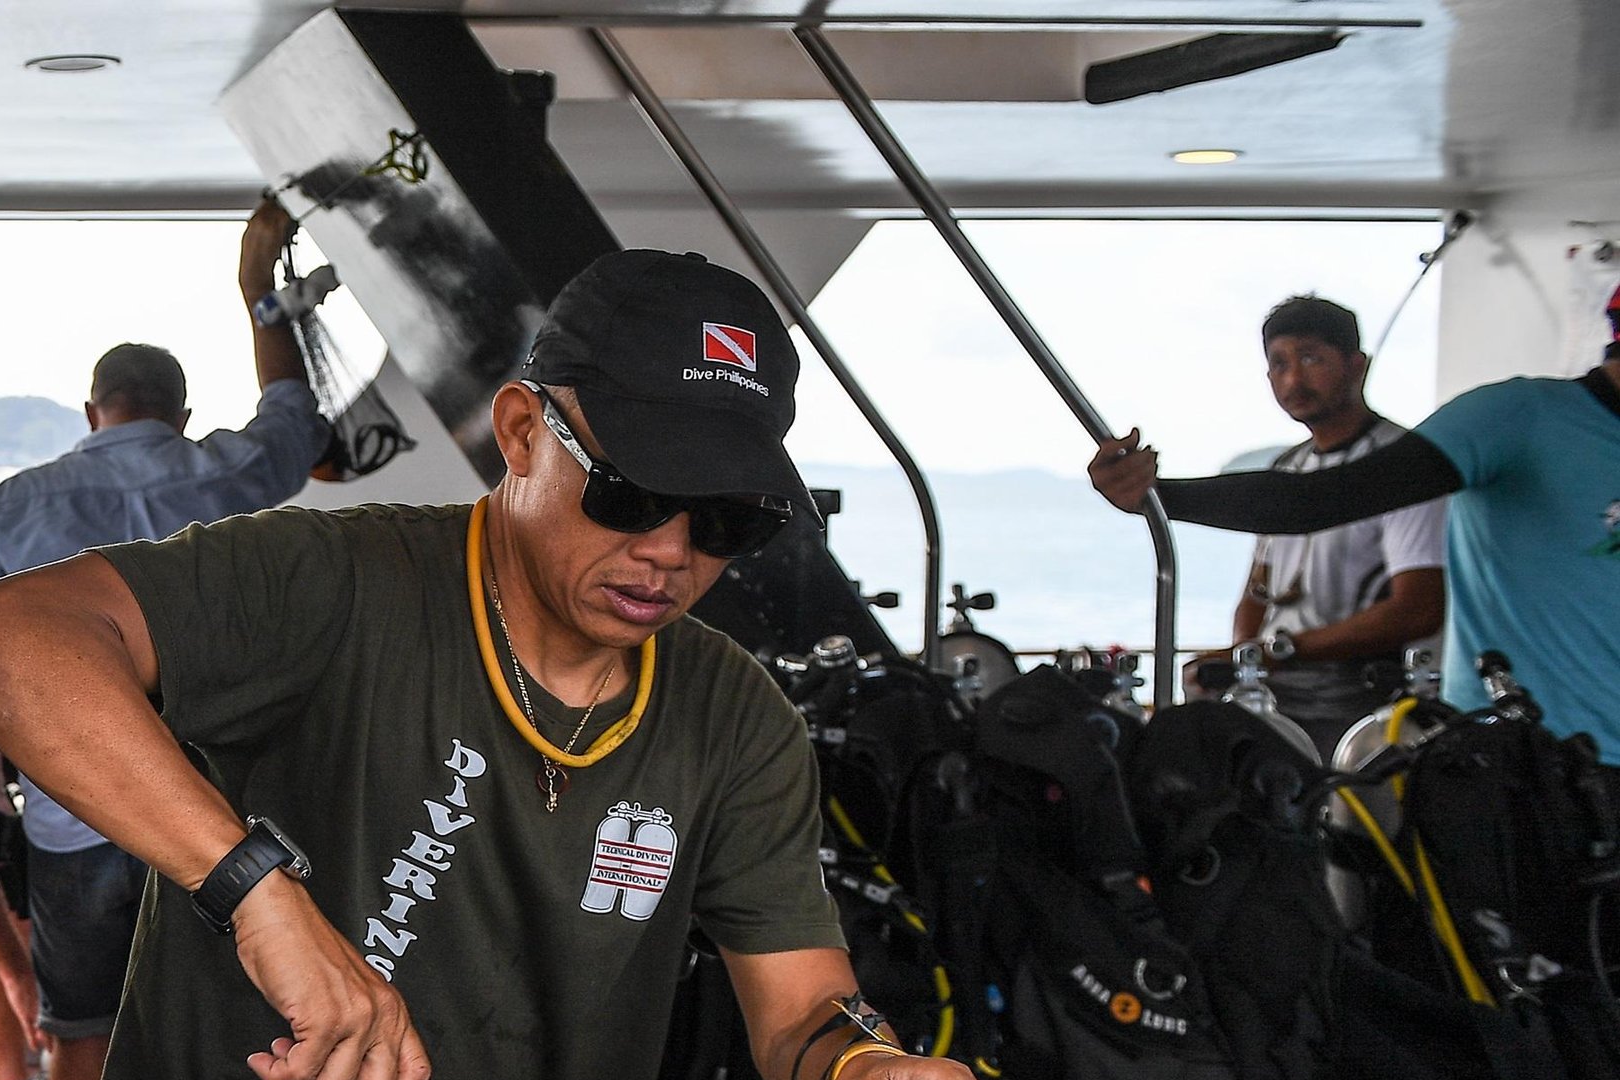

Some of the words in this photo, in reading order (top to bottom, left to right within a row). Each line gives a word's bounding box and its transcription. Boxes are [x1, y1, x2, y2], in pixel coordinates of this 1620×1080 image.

[682, 368, 714, 380] Dive
[715, 369, 770, 397] Philippines
[635, 850, 669, 863] DIVING
